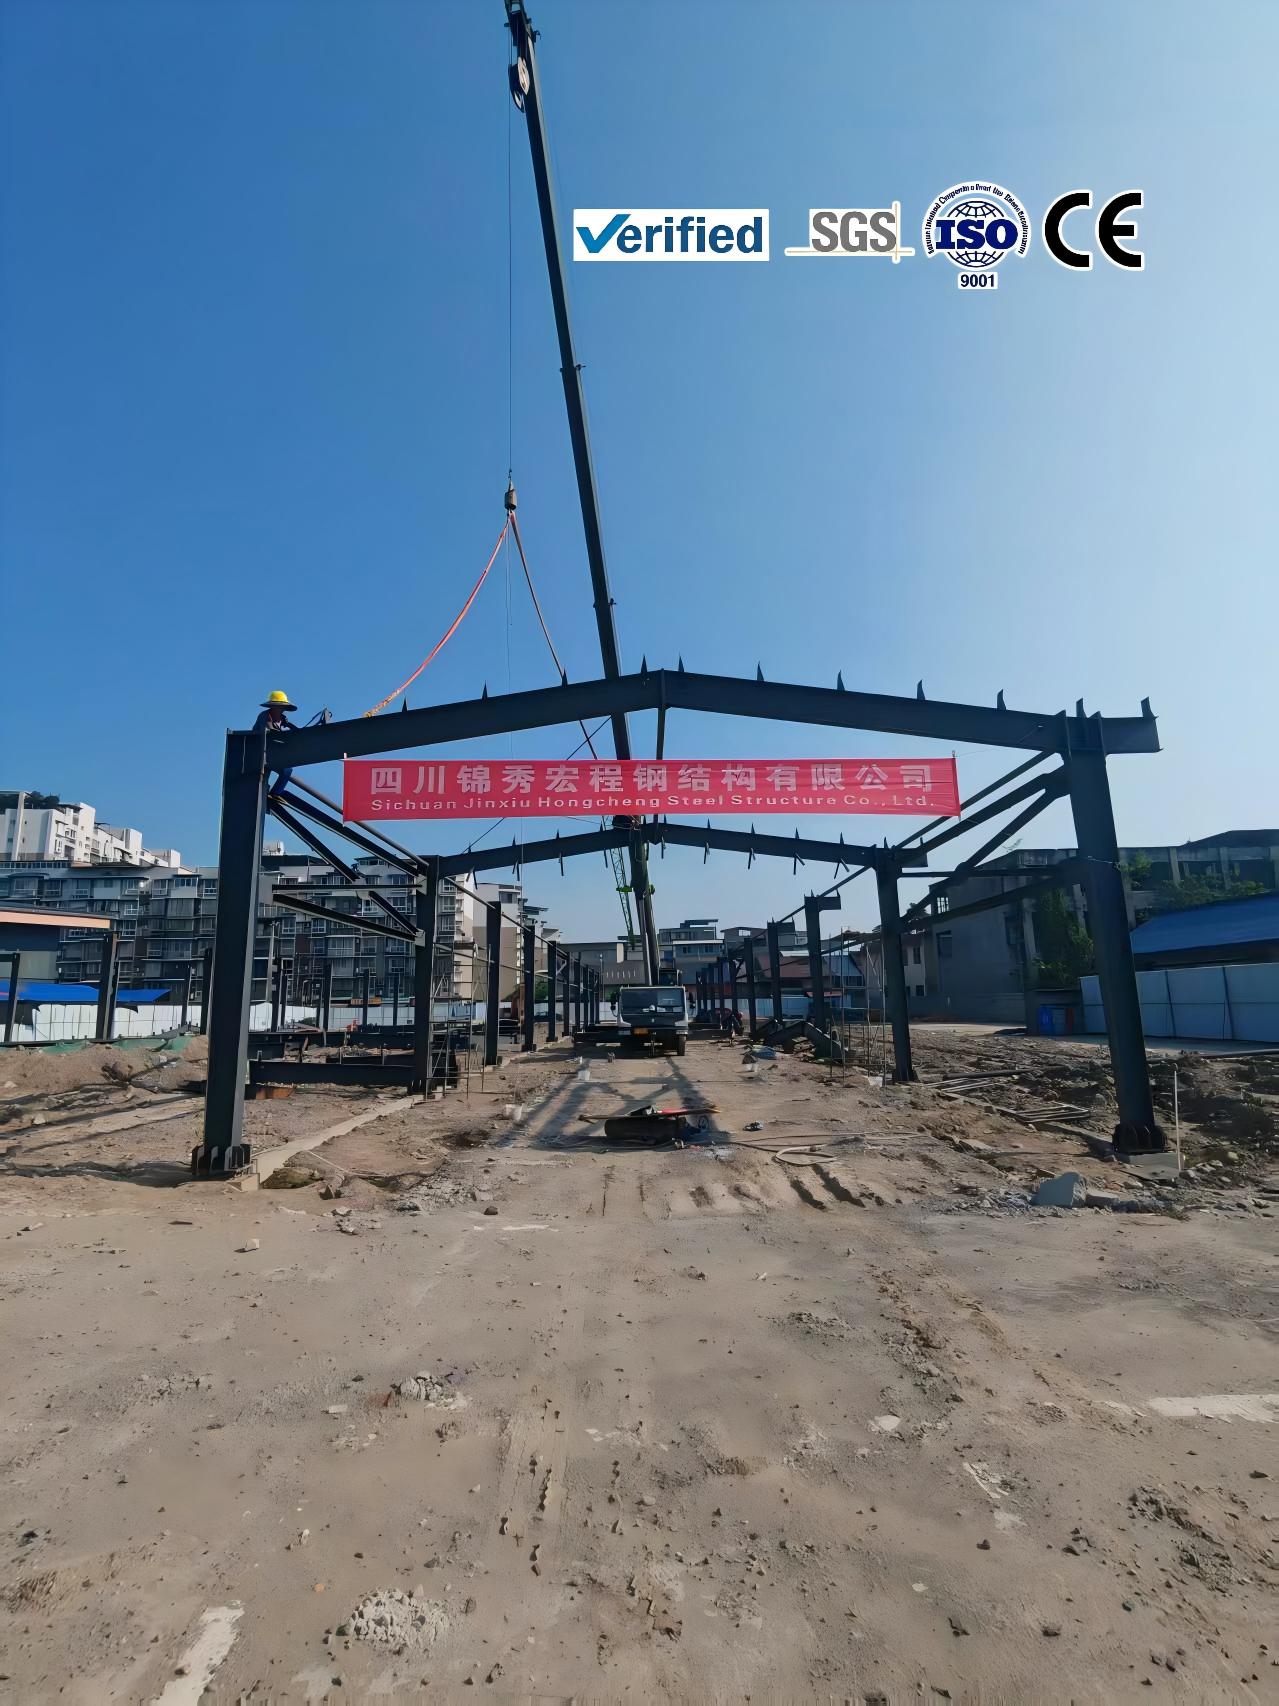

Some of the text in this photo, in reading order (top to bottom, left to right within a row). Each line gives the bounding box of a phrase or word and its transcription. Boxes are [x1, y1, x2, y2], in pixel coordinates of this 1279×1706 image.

[370, 763, 932, 794] 四川锦秀宏程钢结构有限公司
[371, 798, 457, 811] Sichuan
[464, 797, 530, 809] Jinxiu
[538, 796, 660, 809] Hongcheng
[667, 795, 723, 806] Steel
[731, 795, 836, 806] Structure
[893, 795, 934, 807] Ltd.
